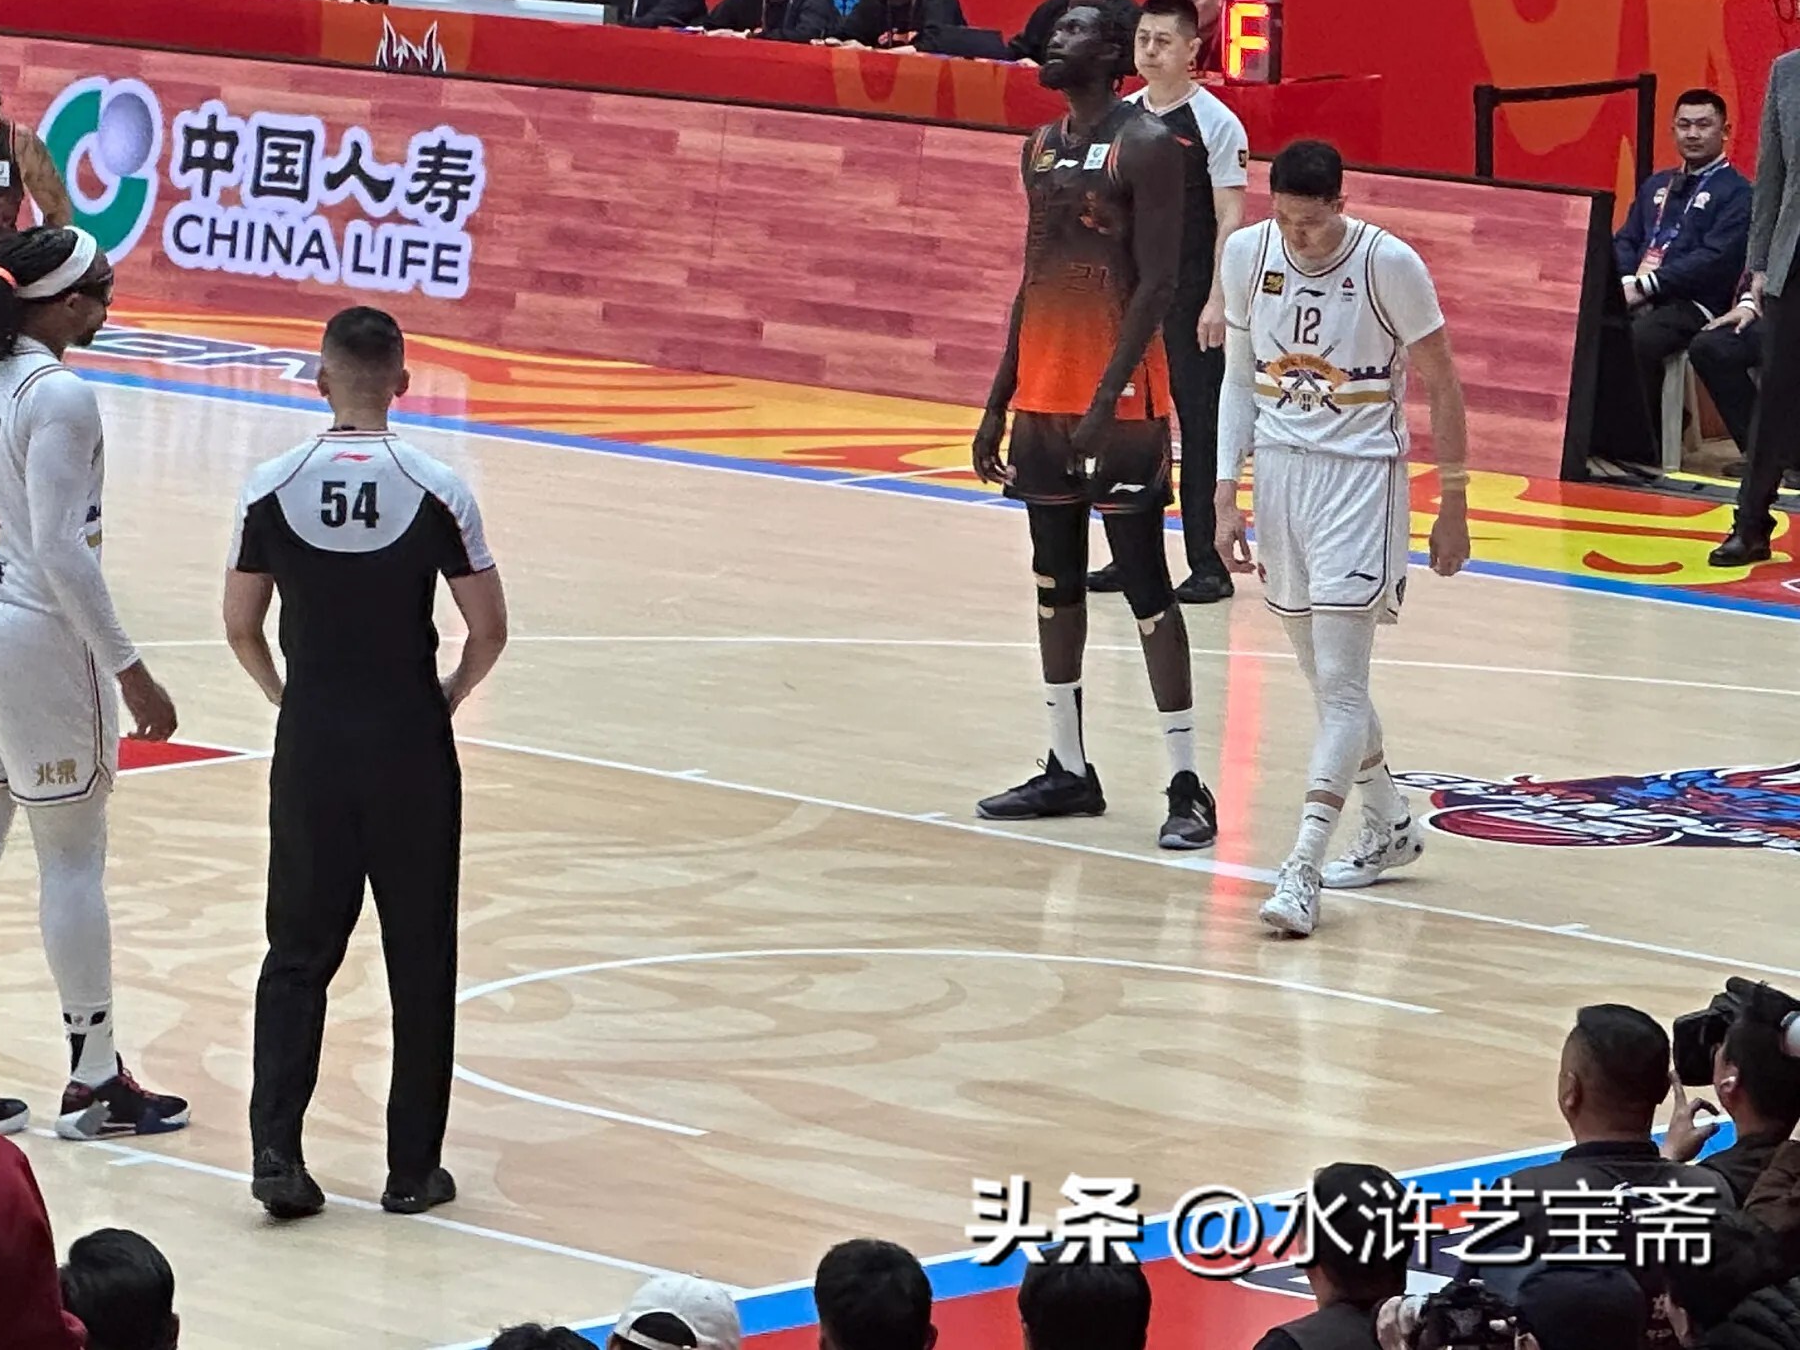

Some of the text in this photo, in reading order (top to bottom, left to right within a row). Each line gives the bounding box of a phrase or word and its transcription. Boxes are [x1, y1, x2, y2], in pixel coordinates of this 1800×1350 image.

[1225, 1, 1270, 80] F
[179, 113, 476, 222] 中国人寿
[172, 214, 464, 285] CHINA LIFE
[1293, 305, 1321, 345] 12
[319, 481, 380, 529] 54
